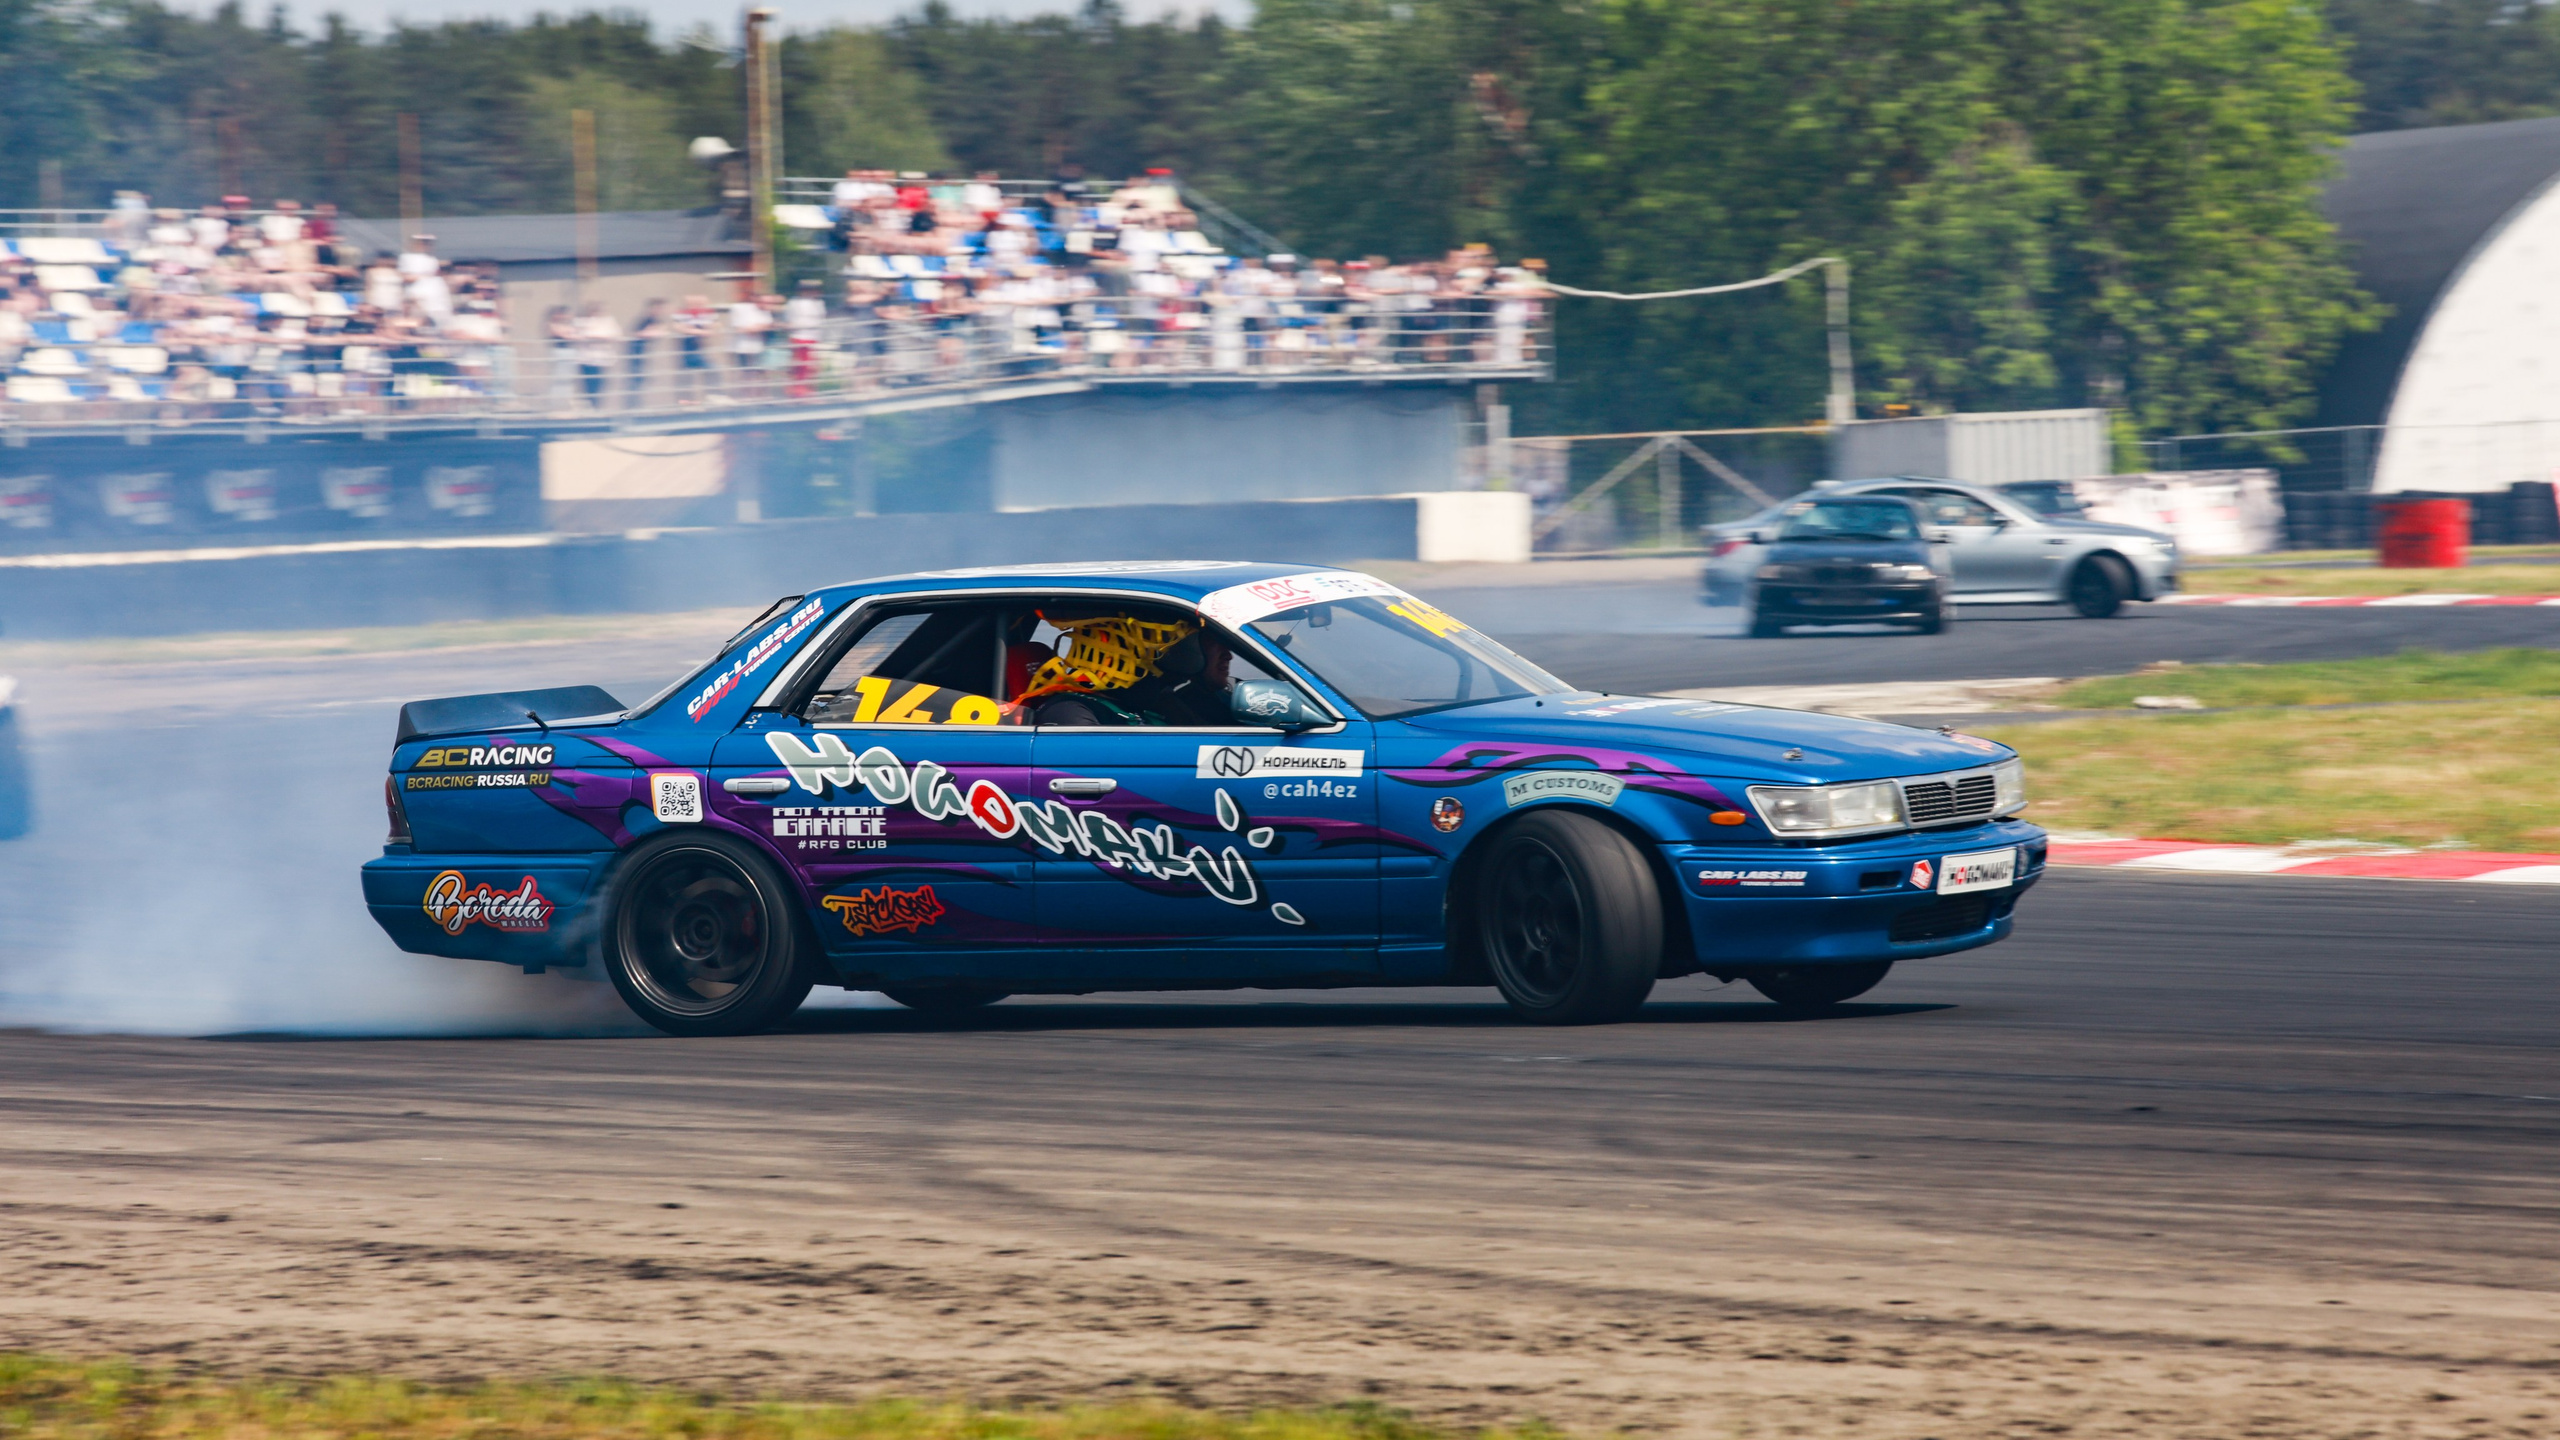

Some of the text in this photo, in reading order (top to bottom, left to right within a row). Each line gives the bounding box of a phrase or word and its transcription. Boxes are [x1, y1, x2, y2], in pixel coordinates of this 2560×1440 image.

[743, 608, 825, 677] TUNING CENTER
[687, 597, 822, 716] CAR-LABS.RU
[1263, 757, 1347, 769] НОРНИКЕЛЬ
[407, 773, 549, 789] BCRACING-RUSSIA.RU
[1263, 779, 1358, 799] @cah4ez
[1533, 777, 1616, 796] CUSTOMS
[773, 818, 887, 837] GARAGE
[798, 840, 888, 850] #RFG CLUB
[1698, 870, 1808, 880] CAR-LABS.RU
[428, 875, 550, 931] Boroda
